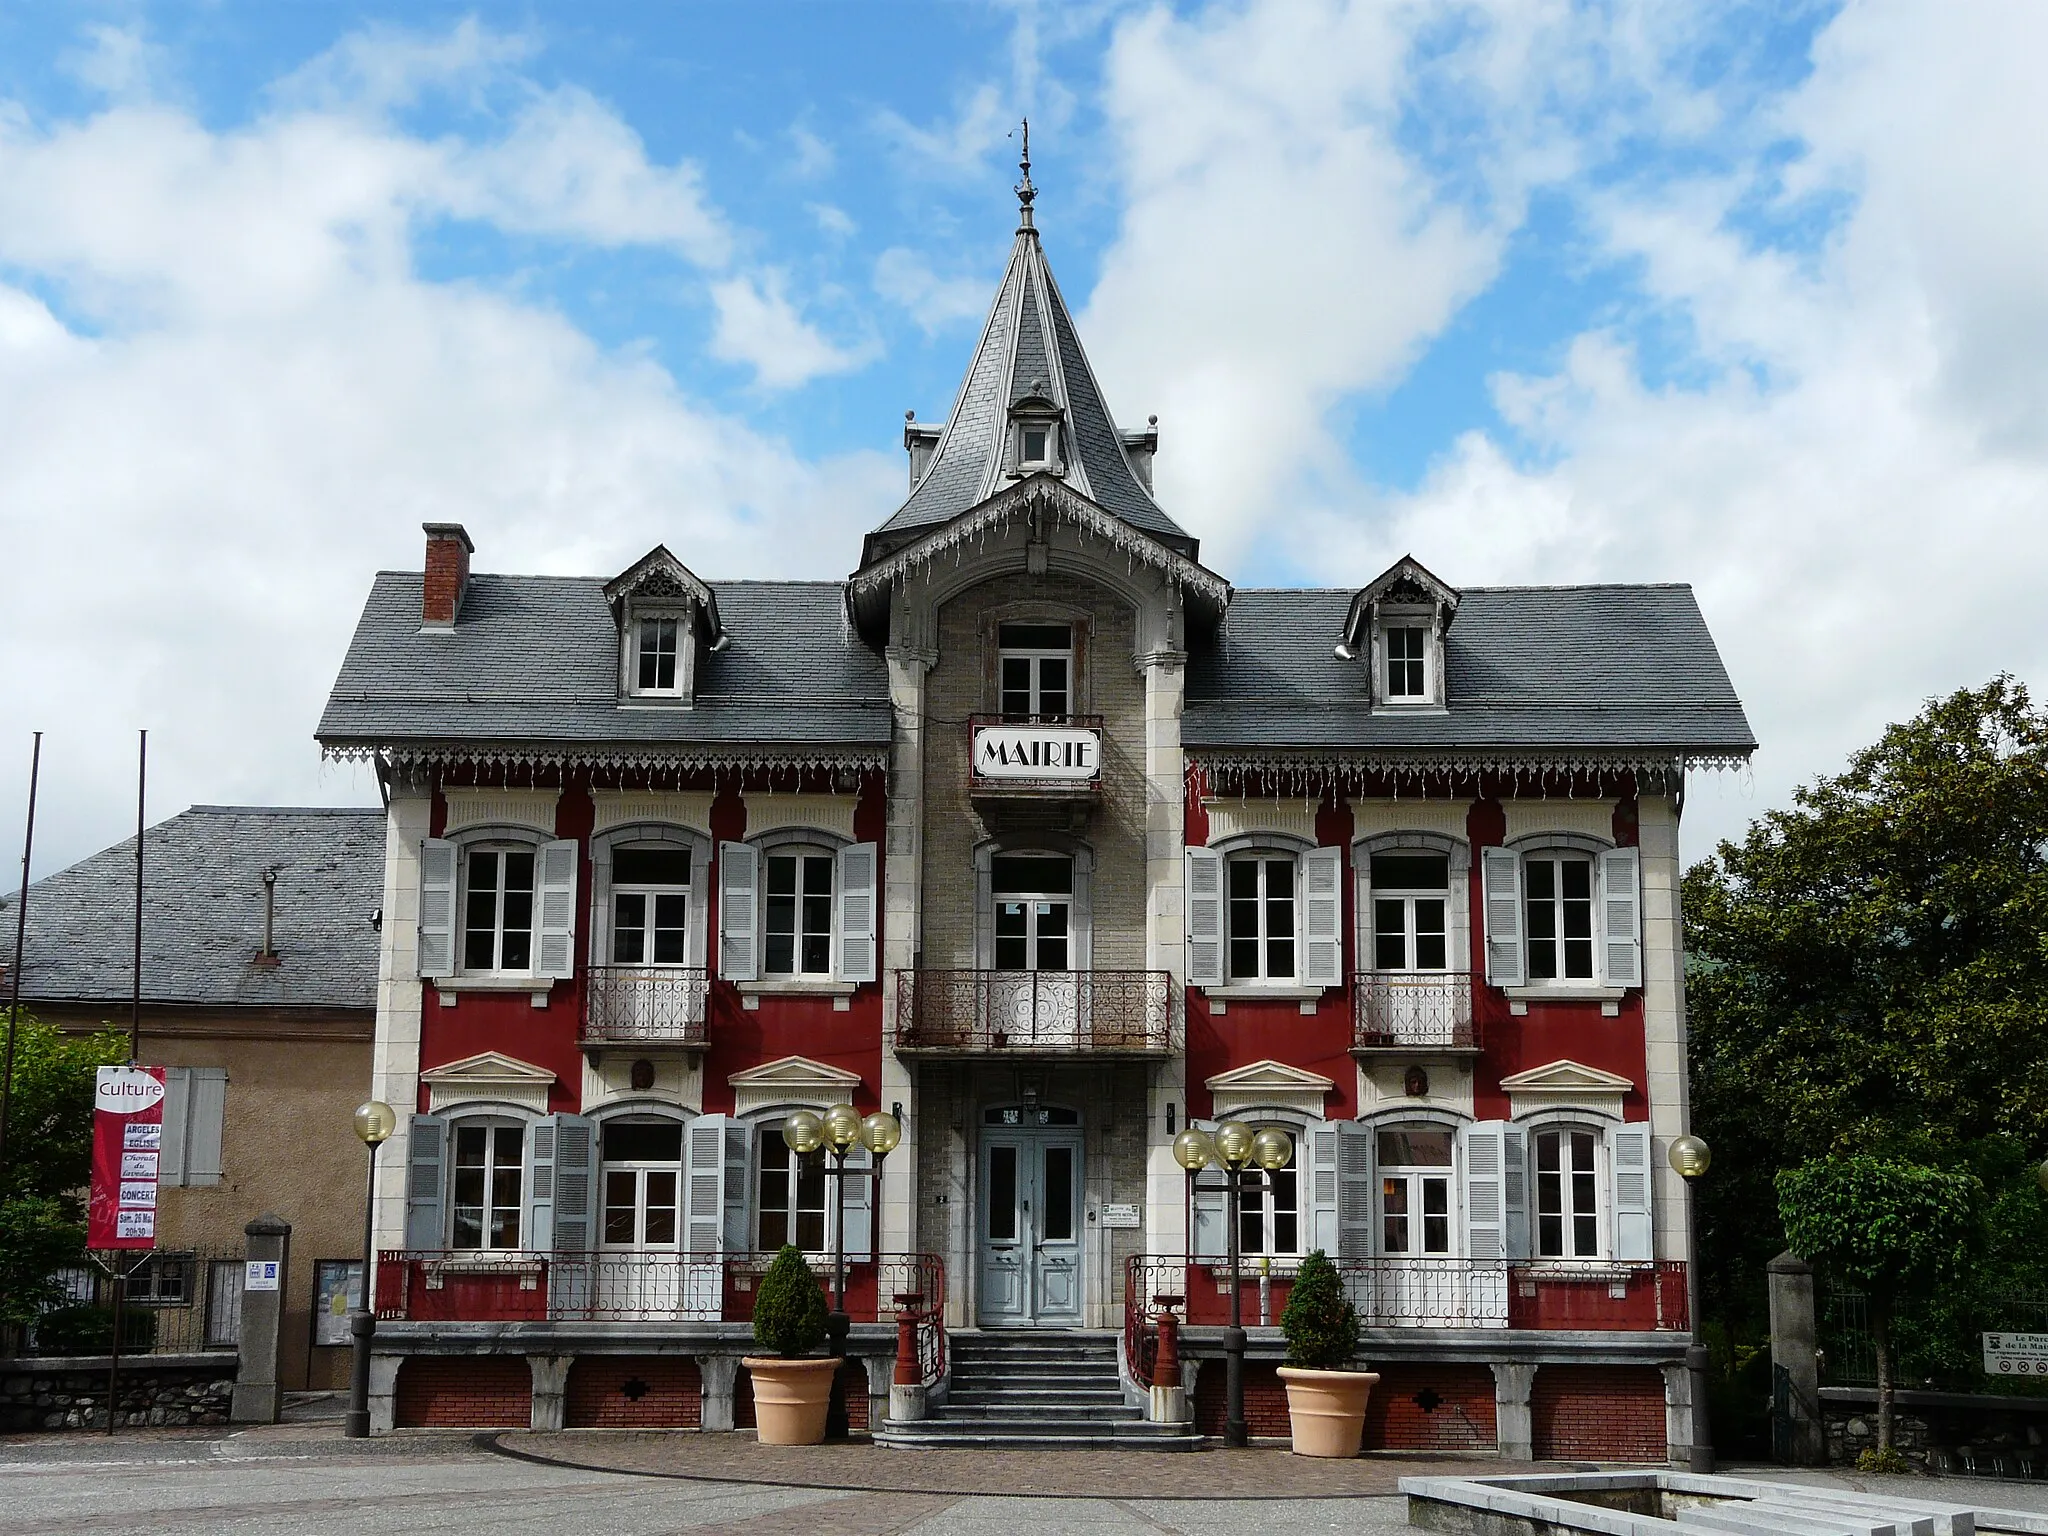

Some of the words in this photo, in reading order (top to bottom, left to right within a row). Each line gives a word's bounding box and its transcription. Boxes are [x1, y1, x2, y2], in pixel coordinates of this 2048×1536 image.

[981, 740, 1092, 768] MAIRIE
[100, 1081, 162, 1096] Culture
[126, 1125, 160, 1134] ARGELES
[129, 1139, 155, 1148] EGLISE
[121, 1190, 155, 1200] CONCERT
[119, 1213, 134, 1224] Sam.
[134, 1213, 142, 1223] 26
[125, 1227, 146, 1237] 20h30
